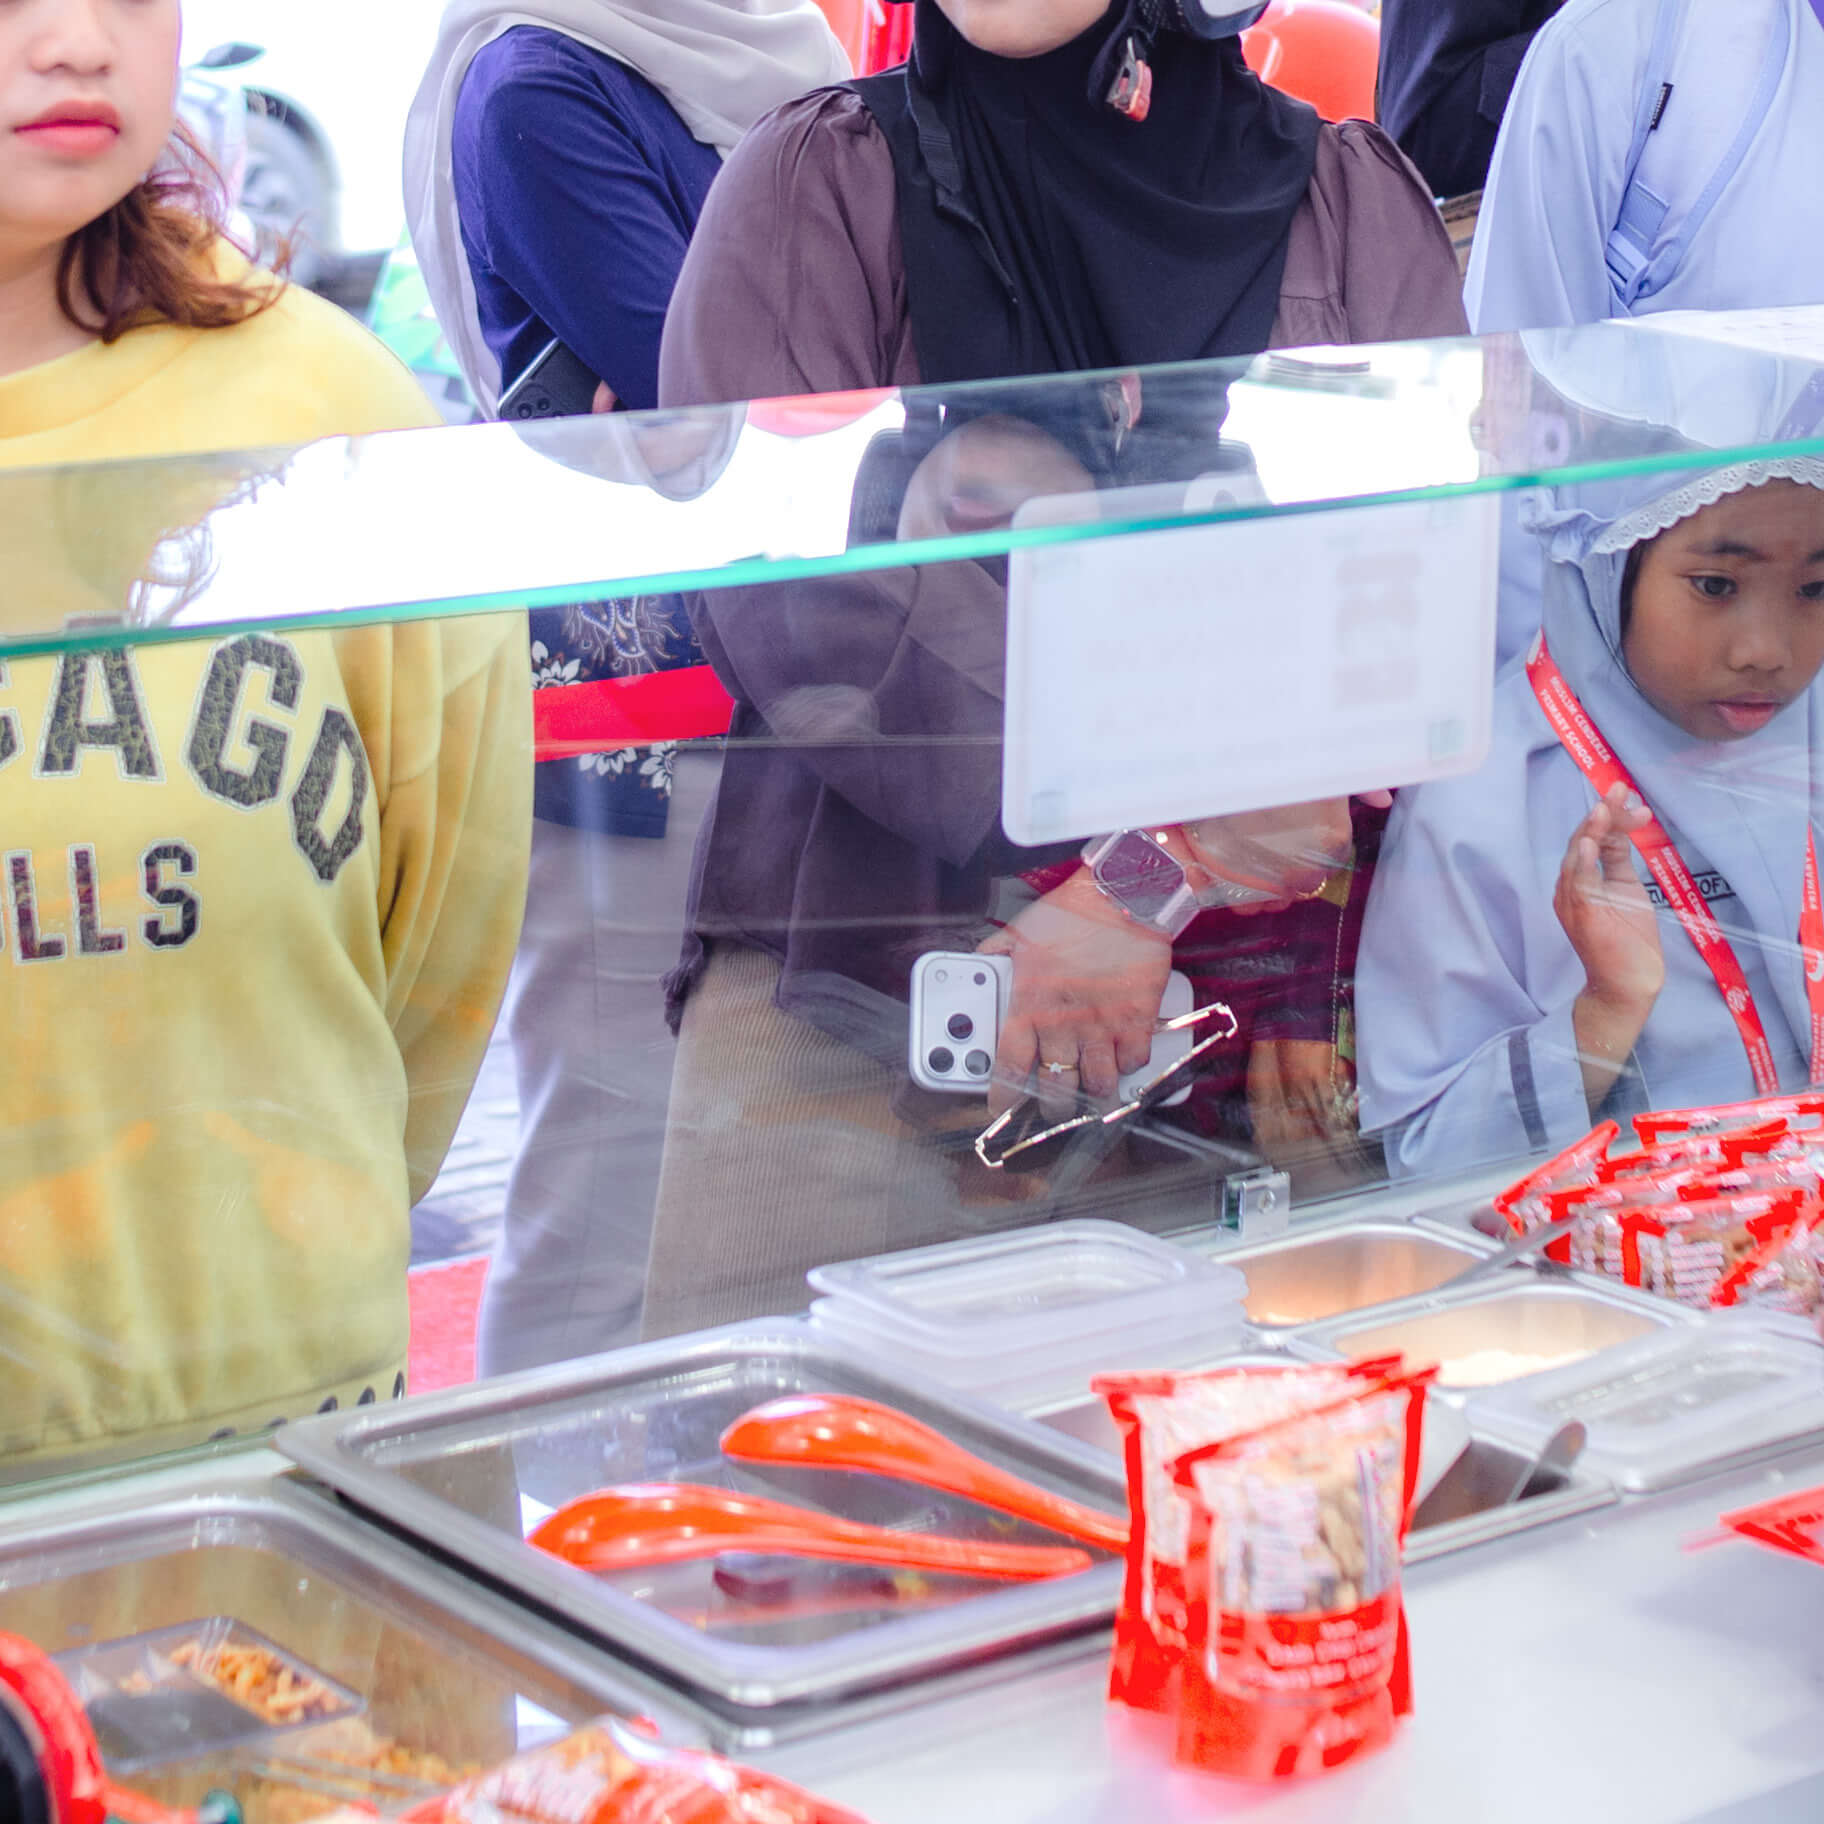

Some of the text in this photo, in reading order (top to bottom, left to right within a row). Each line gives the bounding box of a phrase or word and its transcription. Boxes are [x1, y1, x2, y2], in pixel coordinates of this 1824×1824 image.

[1537, 687, 1596, 771] PRIMARY SCHOOL
[1548, 674, 1612, 764] MUSLIM CENDEKIA
[1648, 855, 1684, 908] PRIMARY
[1659, 844, 1692, 892] MUSLIM
